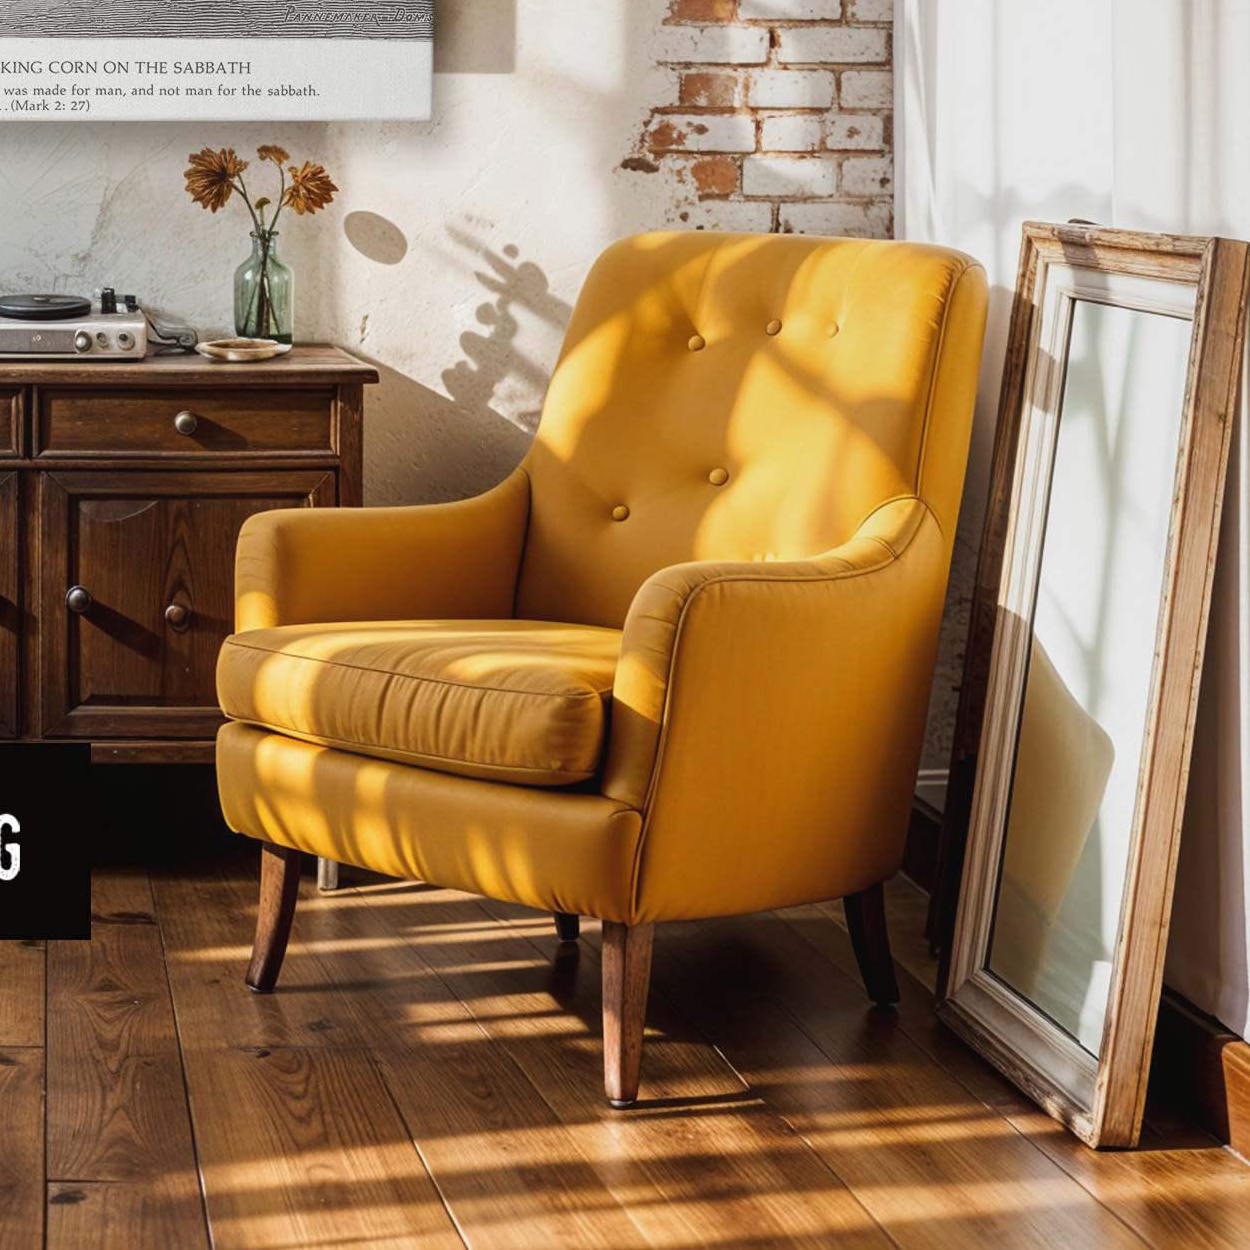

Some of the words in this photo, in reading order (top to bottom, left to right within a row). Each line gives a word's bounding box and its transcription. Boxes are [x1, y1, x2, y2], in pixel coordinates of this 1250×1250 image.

[48, 60, 98, 75] CORN
[103, 60, 129, 75] ON
[134, 61, 168, 75] THE
[173, 61, 251, 75] SABBATH
[3, 87, 28, 96] was
[33, 83, 67, 96] made
[71, 83, 91, 96] for
[95, 87, 127, 98] man,
[130, 83, 154, 96] and
[158, 86, 181, 96] not
[185, 87, 213, 96] man
[217, 83, 237, 96] for
[241, 83, 262, 96] the
[267, 83, 320, 97] sabbath.
[54, 100, 66, 112] 2:
[70, 99, 91, 112] 27)
